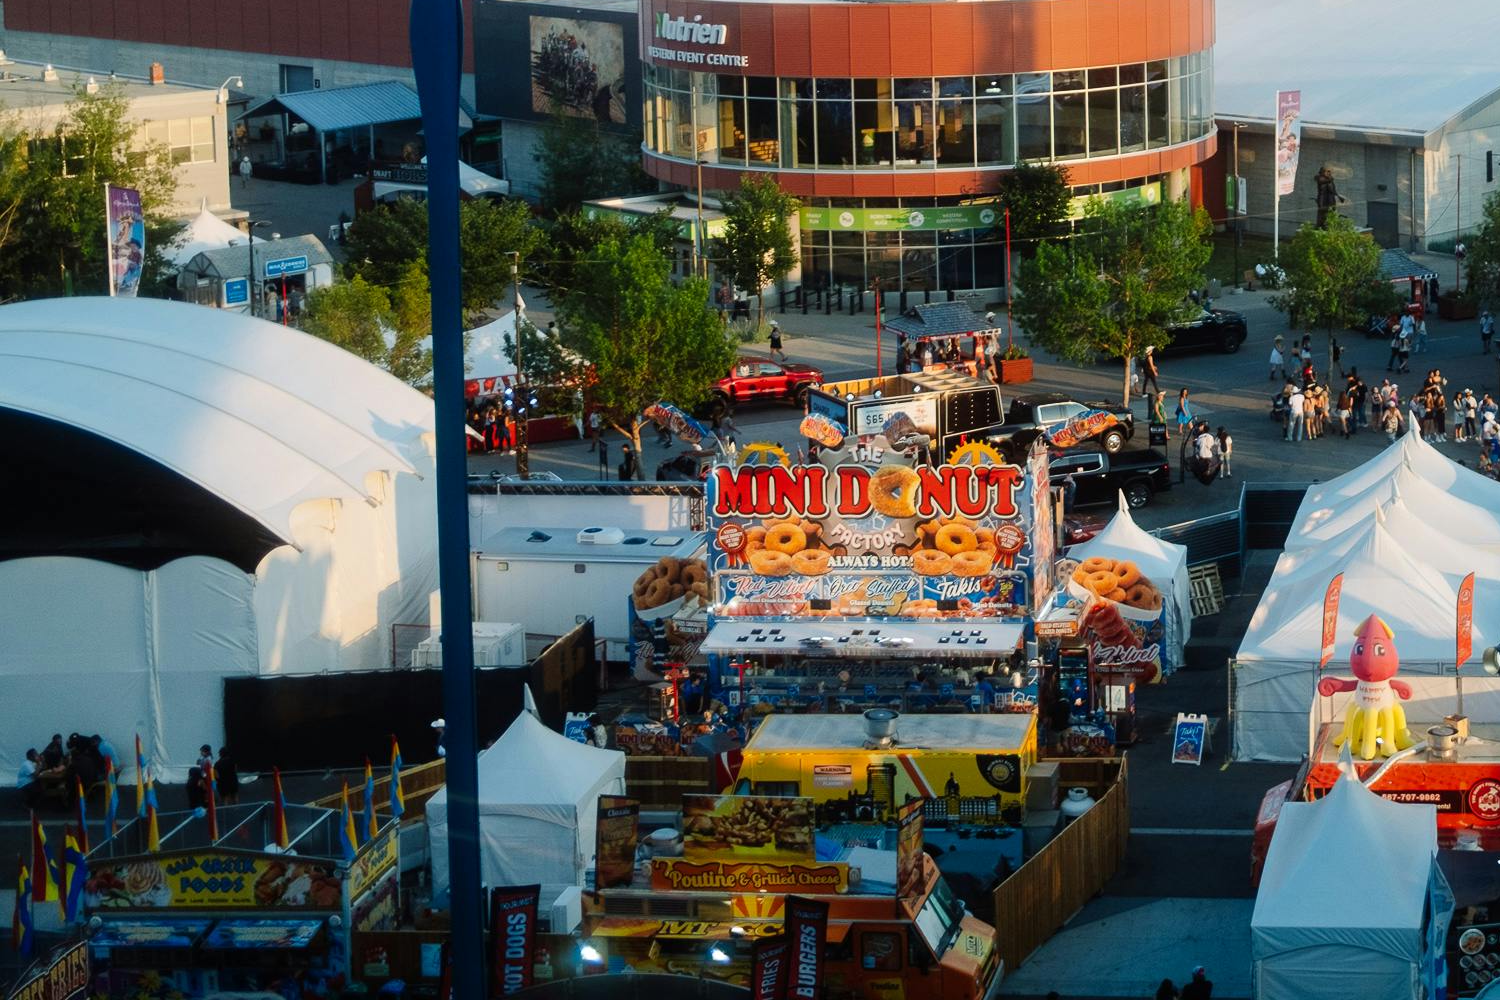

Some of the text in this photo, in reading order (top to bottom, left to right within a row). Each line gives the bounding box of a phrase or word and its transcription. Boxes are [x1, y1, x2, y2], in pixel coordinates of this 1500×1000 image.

[656, 12, 727, 45] Nutrien
[676, 50, 706, 63] EVENT
[706, 53, 749, 67] CENTRE
[866, 414, 884, 425] $65
[847, 447, 884, 464] THE
[713, 464, 829, 519] MINI
[831, 521, 906, 550] FACTORY
[827, 555, 879, 568] ALWAYS
[734, 576, 819, 598] Red Velvet
[828, 576, 918, 600] Oreo Stuffed
[936, 577, 981, 601] Takis
[201, 856, 257, 874] GREEK
[180, 877, 245, 893] FOODS
[668, 871, 842, 889] Poutine & Grilled Cheese
[504, 911, 529, 959] DOGS
[796, 923, 819, 999] BURGERS
